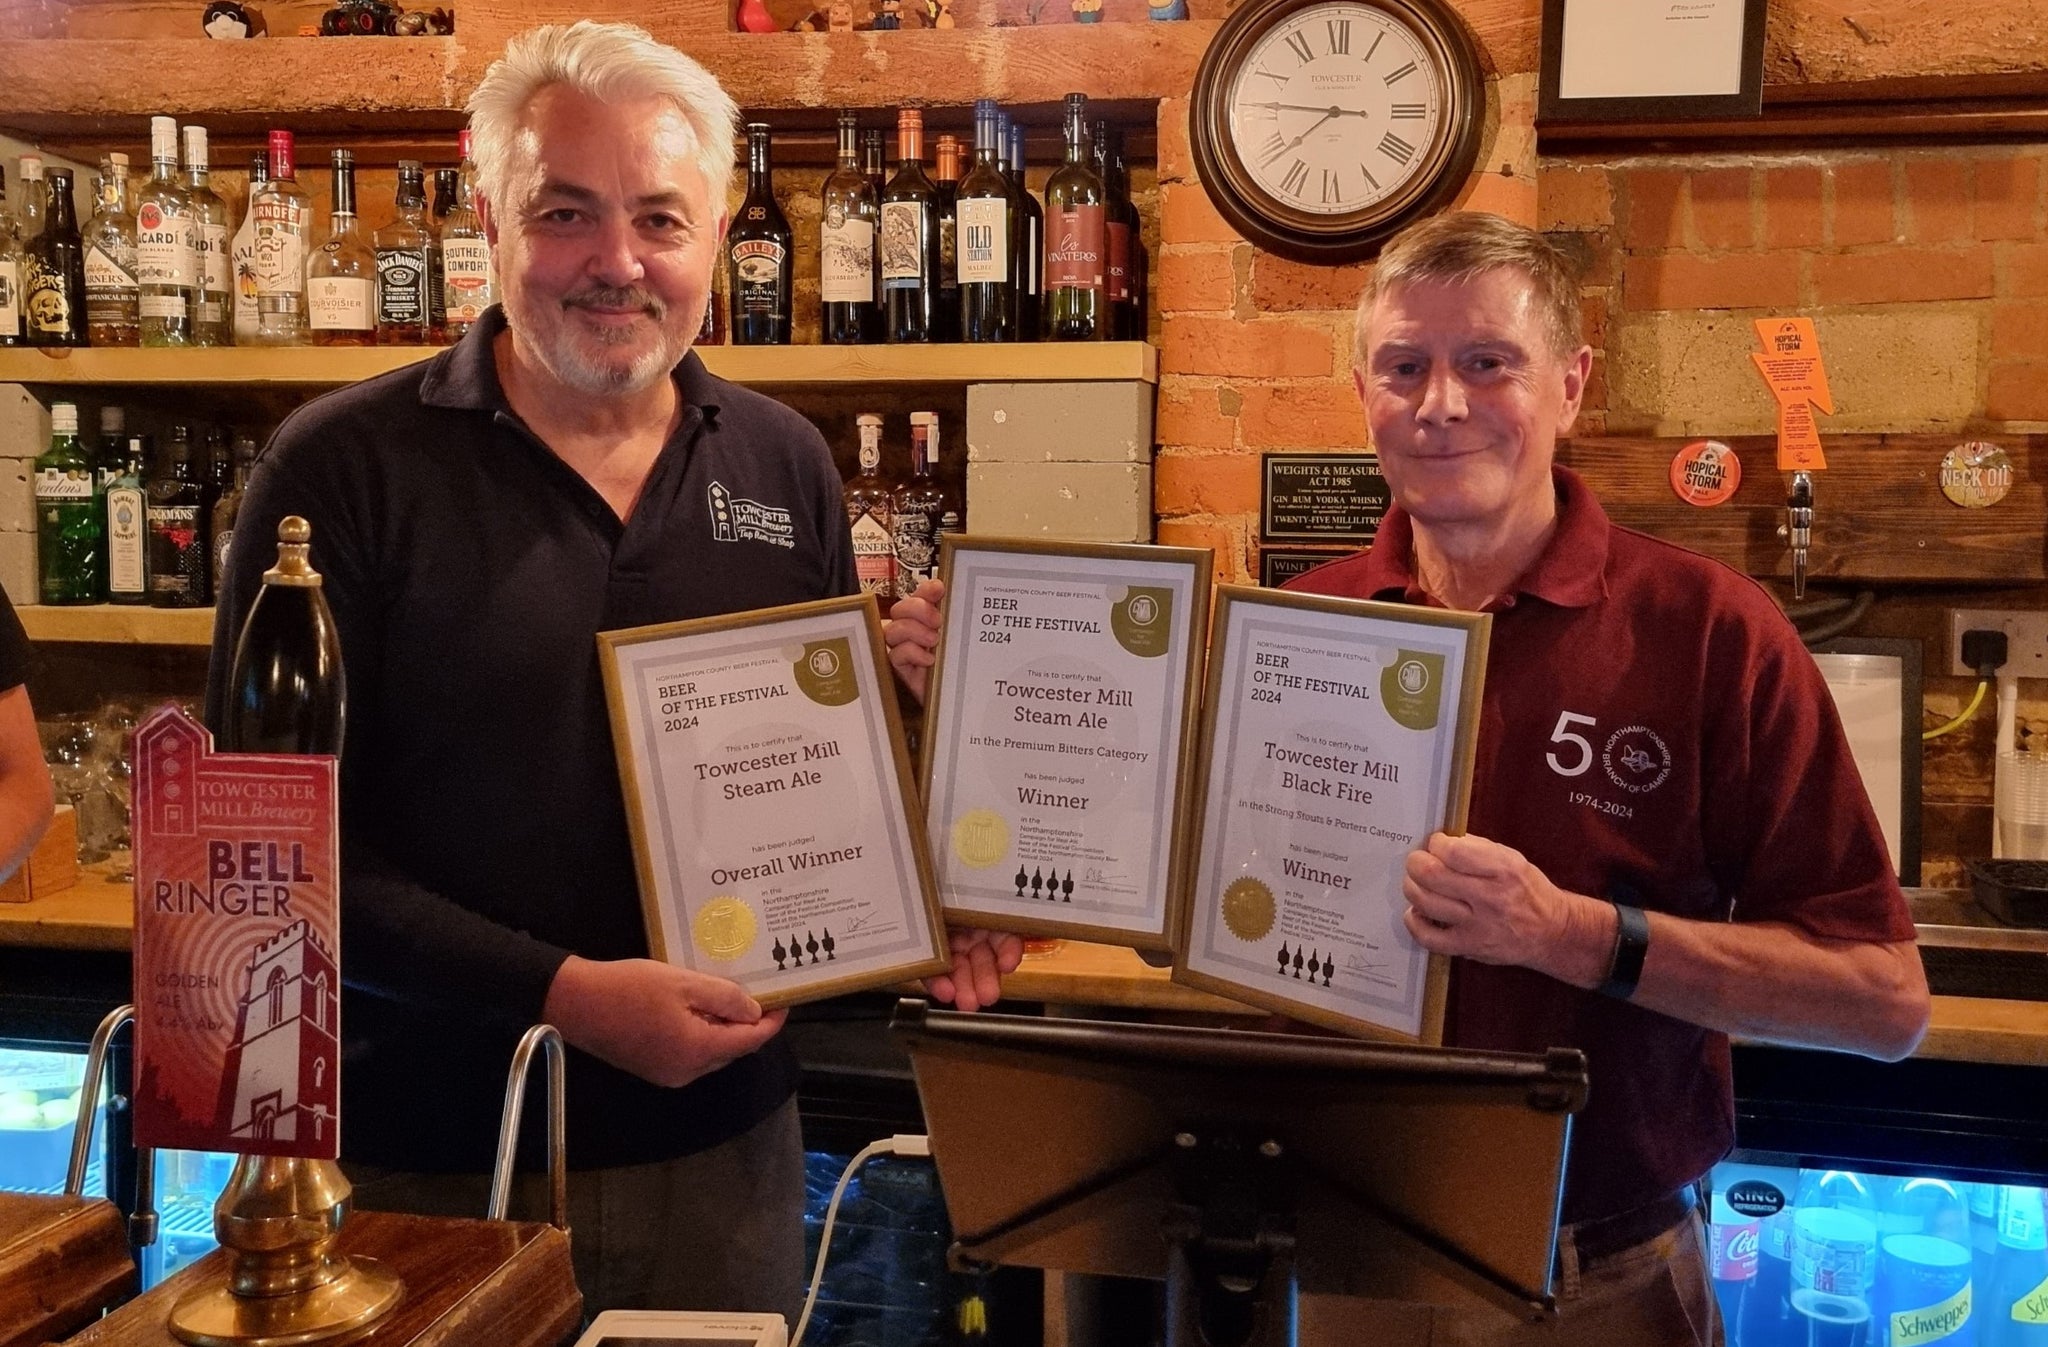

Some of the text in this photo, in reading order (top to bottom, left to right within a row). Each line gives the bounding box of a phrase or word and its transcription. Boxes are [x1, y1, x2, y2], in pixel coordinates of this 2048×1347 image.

[1326, 20, 1351, 55] XII
[1391, 104, 1426, 120] III
[967, 226, 992, 248] OLD
[736, 244, 780, 257] BAILEYS
[967, 249, 992, 261] STATION
[378, 254, 424, 273] JACK DANIEL'S
[448, 261, 489, 271] COMFORT
[1775, 334, 1803, 342] HOPICAL
[1777, 343, 1800, 351] STORM
[1274, 466, 1382, 476] WEIGHTS & MEASURE
[1684, 460, 1727, 478] HOPICAL
[1942, 468, 2011, 487] NECK OIL
[1309, 478, 1351, 486] ACT 1985
[1684, 473, 1722, 490] STORM
[1316, 496, 1345, 504] VODKA
[733, 504, 791, 523] TOWCESTER
[737, 515, 761, 526] MILL
[1274, 516, 1330, 524] TWENTY-FIVE
[1274, 561, 1306, 571] WINE
[984, 587, 1029, 595] NORTHAMPTON
[983, 598, 1018, 611] BEER
[981, 614, 1101, 634] OF THE FESTIVAL
[979, 631, 1012, 644] 2024
[1255, 653, 1289, 669] BEER
[1257, 641, 1300, 652] NORTHAMPTON
[1301, 647, 1325, 655] COUNTY
[1343, 653, 1371, 663] FESTIVAL
[656, 659, 779, 682] NORTHAMPTON COUNTY FESTIVAL
[1028, 670, 1042, 678] This
[1061, 673, 1085, 682] certify
[658, 683, 697, 698] BEER
[994, 680, 1133, 707] Towcester Mill
[1253, 671, 1370, 700] OF THE FESTIVAL
[661, 684, 789, 715] OF THE FESTIVAL
[1251, 688, 1282, 704] 2024
[664, 716, 699, 733] 2024
[1014, 706, 1108, 729] Steam Ale
[726, 737, 786, 753] This certify
[969, 736, 1149, 763] in the Premium Bitters Category
[1296, 733, 1352, 751] This certify
[1606, 725, 1671, 766] NORTHAMPTONSHIRE
[694, 741, 841, 781] Towcester Mill
[1264, 741, 1399, 783] Towcester Mill
[1039, 773, 1085, 785] been judged
[1602, 754, 1671, 793] BRANCH OF CAMRA
[198, 781, 316, 799] TOWCESTER
[723, 770, 822, 801] Steam Ale
[1281, 772, 1373, 804] Black Fire
[1017, 787, 1089, 810] Winner
[1569, 792, 1633, 819] 1974-2024
[200, 801, 317, 824] MILL Brewery
[1239, 799, 1413, 844] in the Strong Stouts Porters Category
[767, 835, 816, 851] been judged
[208, 840, 314, 883] BELL
[1322, 850, 1348, 862] judged
[711, 845, 864, 886] Overall Winner
[1282, 857, 1352, 890] Winner
[155, 880, 292, 917] RINGER
[156, 974, 218, 988] GOLDEN
[1734, 1191, 1777, 1203] KING
